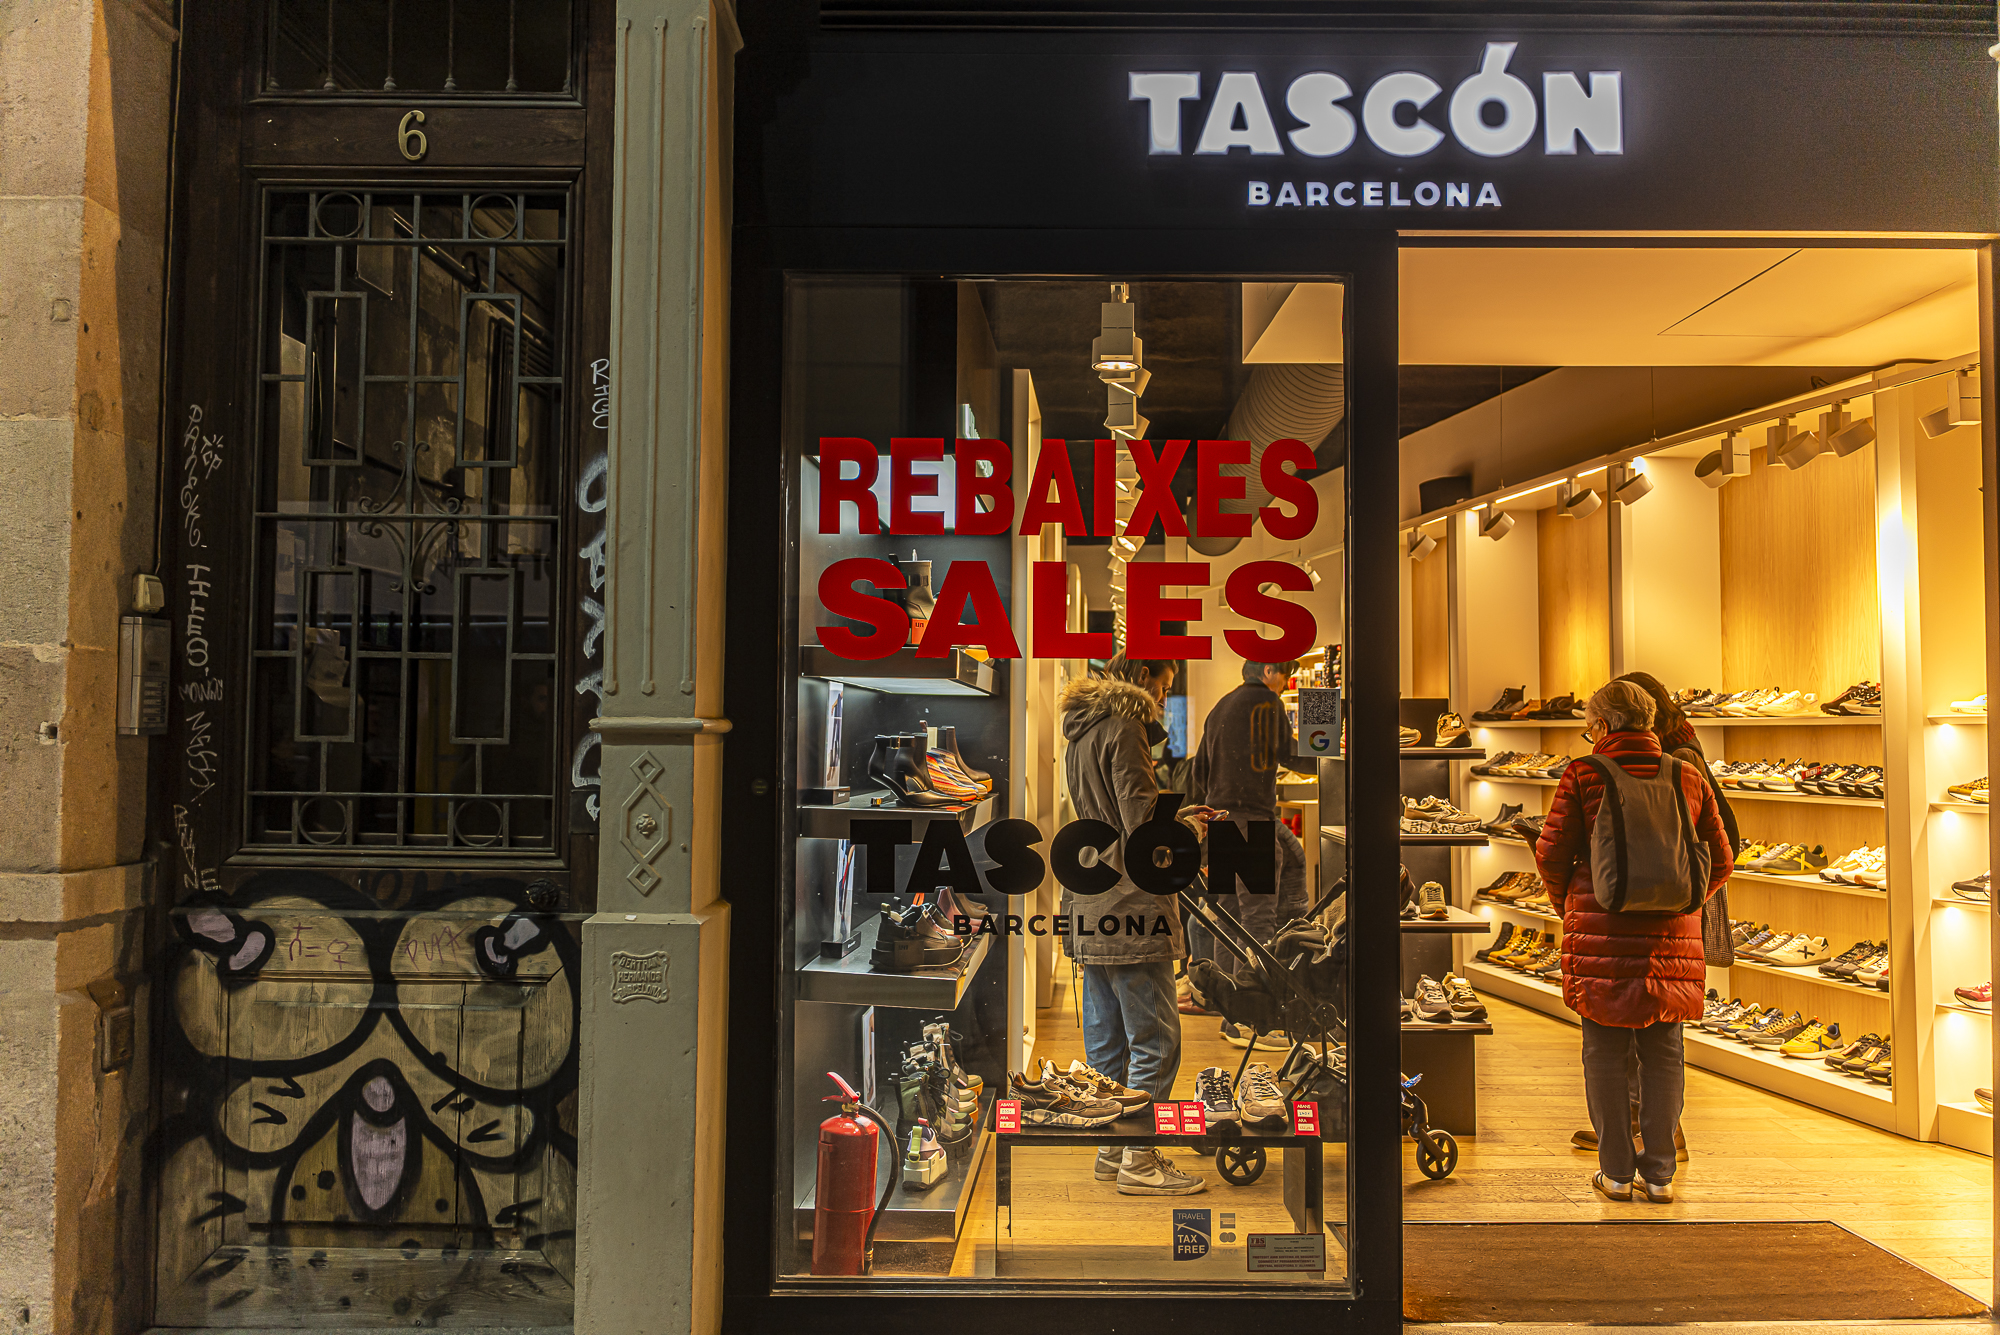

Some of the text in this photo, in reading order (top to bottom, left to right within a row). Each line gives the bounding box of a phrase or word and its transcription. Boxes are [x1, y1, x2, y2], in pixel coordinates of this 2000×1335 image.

[1129, 41, 1625, 158] TASCÓN
[397, 110, 427, 161] 6
[1247, 180, 1502, 208] BARCELONA
[818, 437, 1319, 540] REBAIXES
[816, 558, 1317, 662] SALES
[850, 794, 1276, 895] TASCÓN
[953, 914, 1173, 936] BARCELONA
[617, 971, 662, 983] HERMANOS
[617, 983, 662, 998] BARCELONA
[1177, 1234, 1198, 1243] TAX
[1177, 1245, 1206, 1254] FREE
